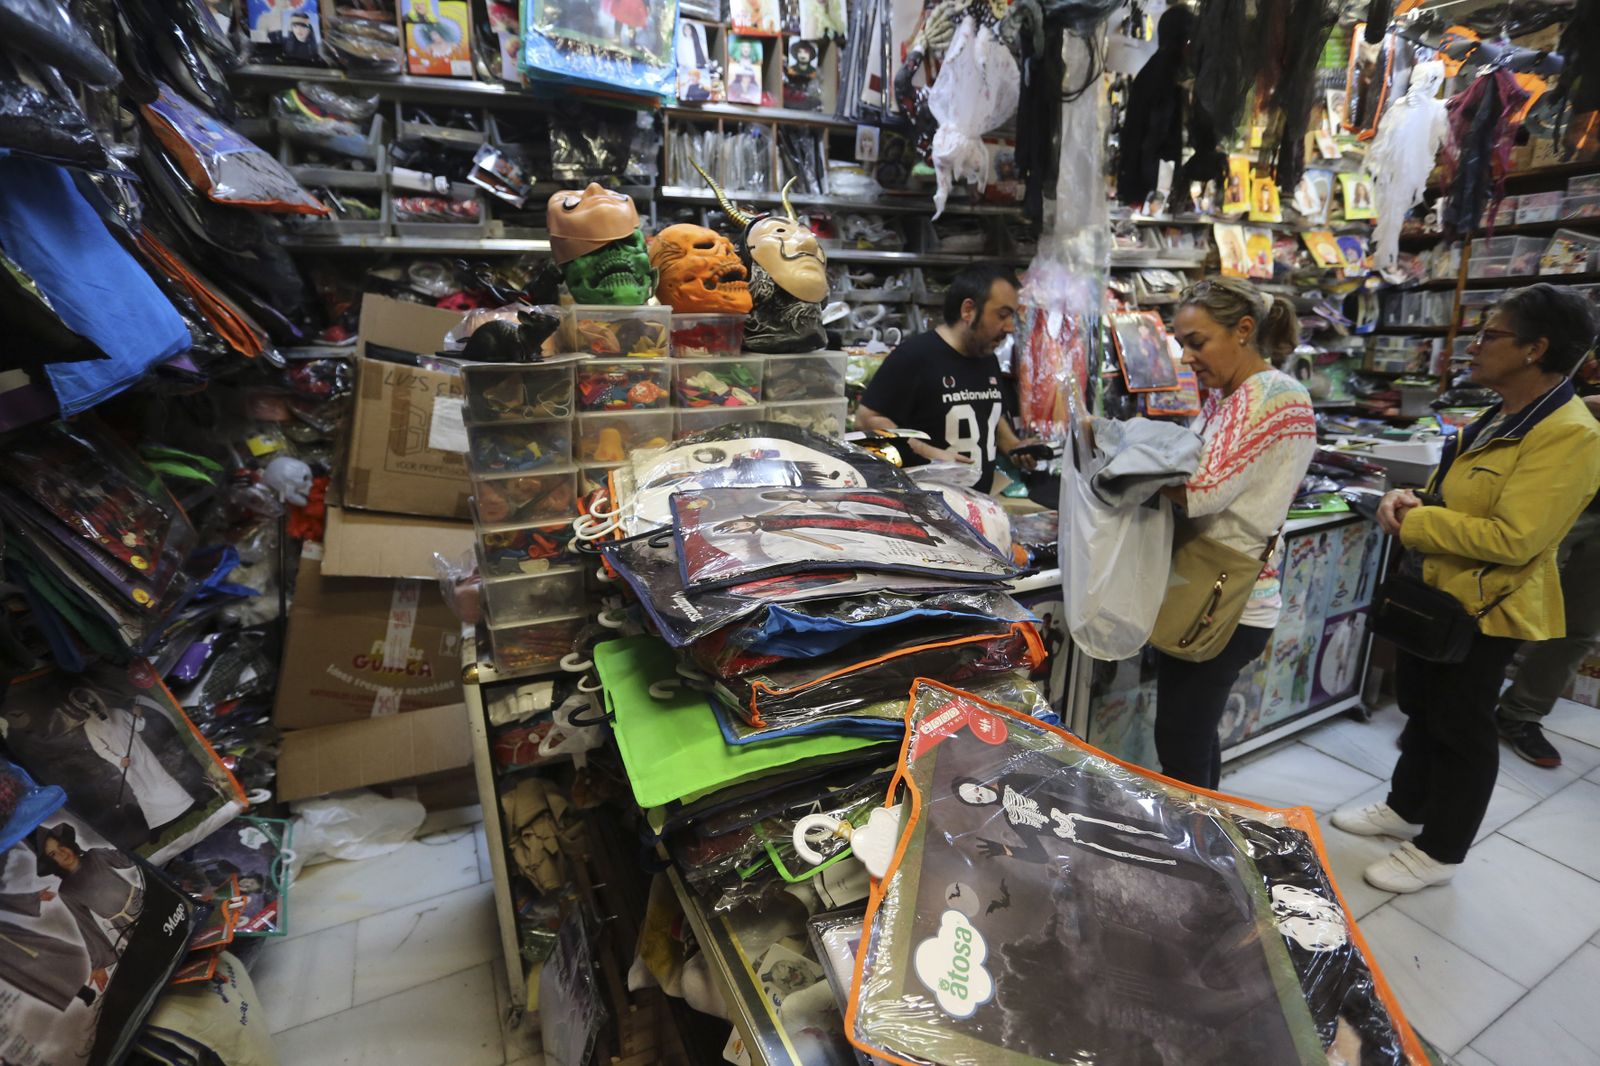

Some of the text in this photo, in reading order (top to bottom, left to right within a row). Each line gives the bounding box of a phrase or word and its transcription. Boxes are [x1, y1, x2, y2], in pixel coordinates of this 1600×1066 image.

[352, 653, 434, 680] GUCA
[163, 903, 186, 937] Mago
[939, 926, 973, 1001] atosa
